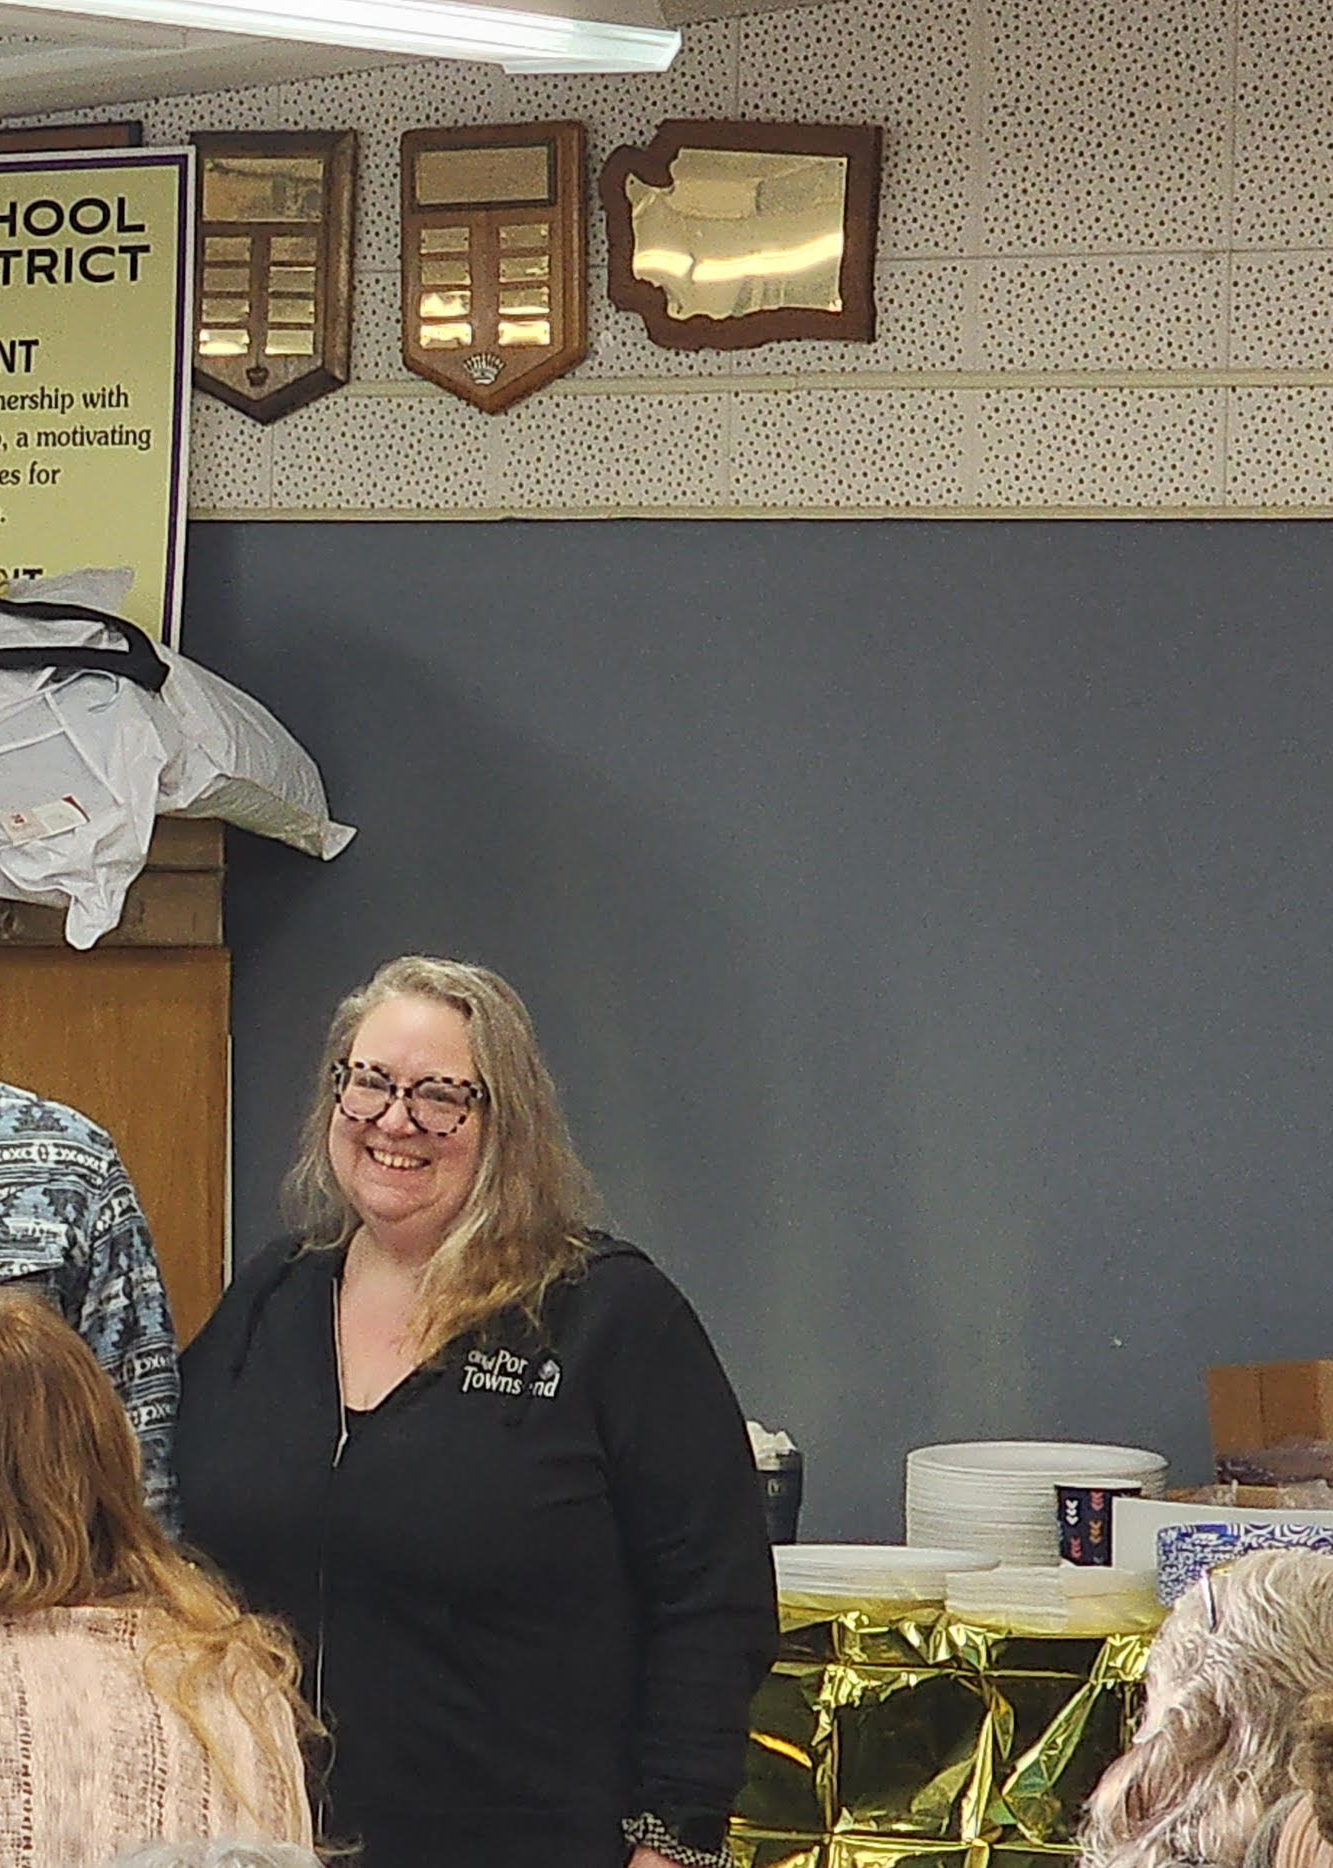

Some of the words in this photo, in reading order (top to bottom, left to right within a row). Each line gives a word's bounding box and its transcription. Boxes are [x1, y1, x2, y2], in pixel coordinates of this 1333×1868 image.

[82, 384, 130, 409] with
[16, 433, 29, 448] a
[37, 424, 151, 451] motivating
[28, 461, 62, 485] for
[494, 1349, 529, 1375] Por
[462, 1365, 561, 1397] Townsnd
